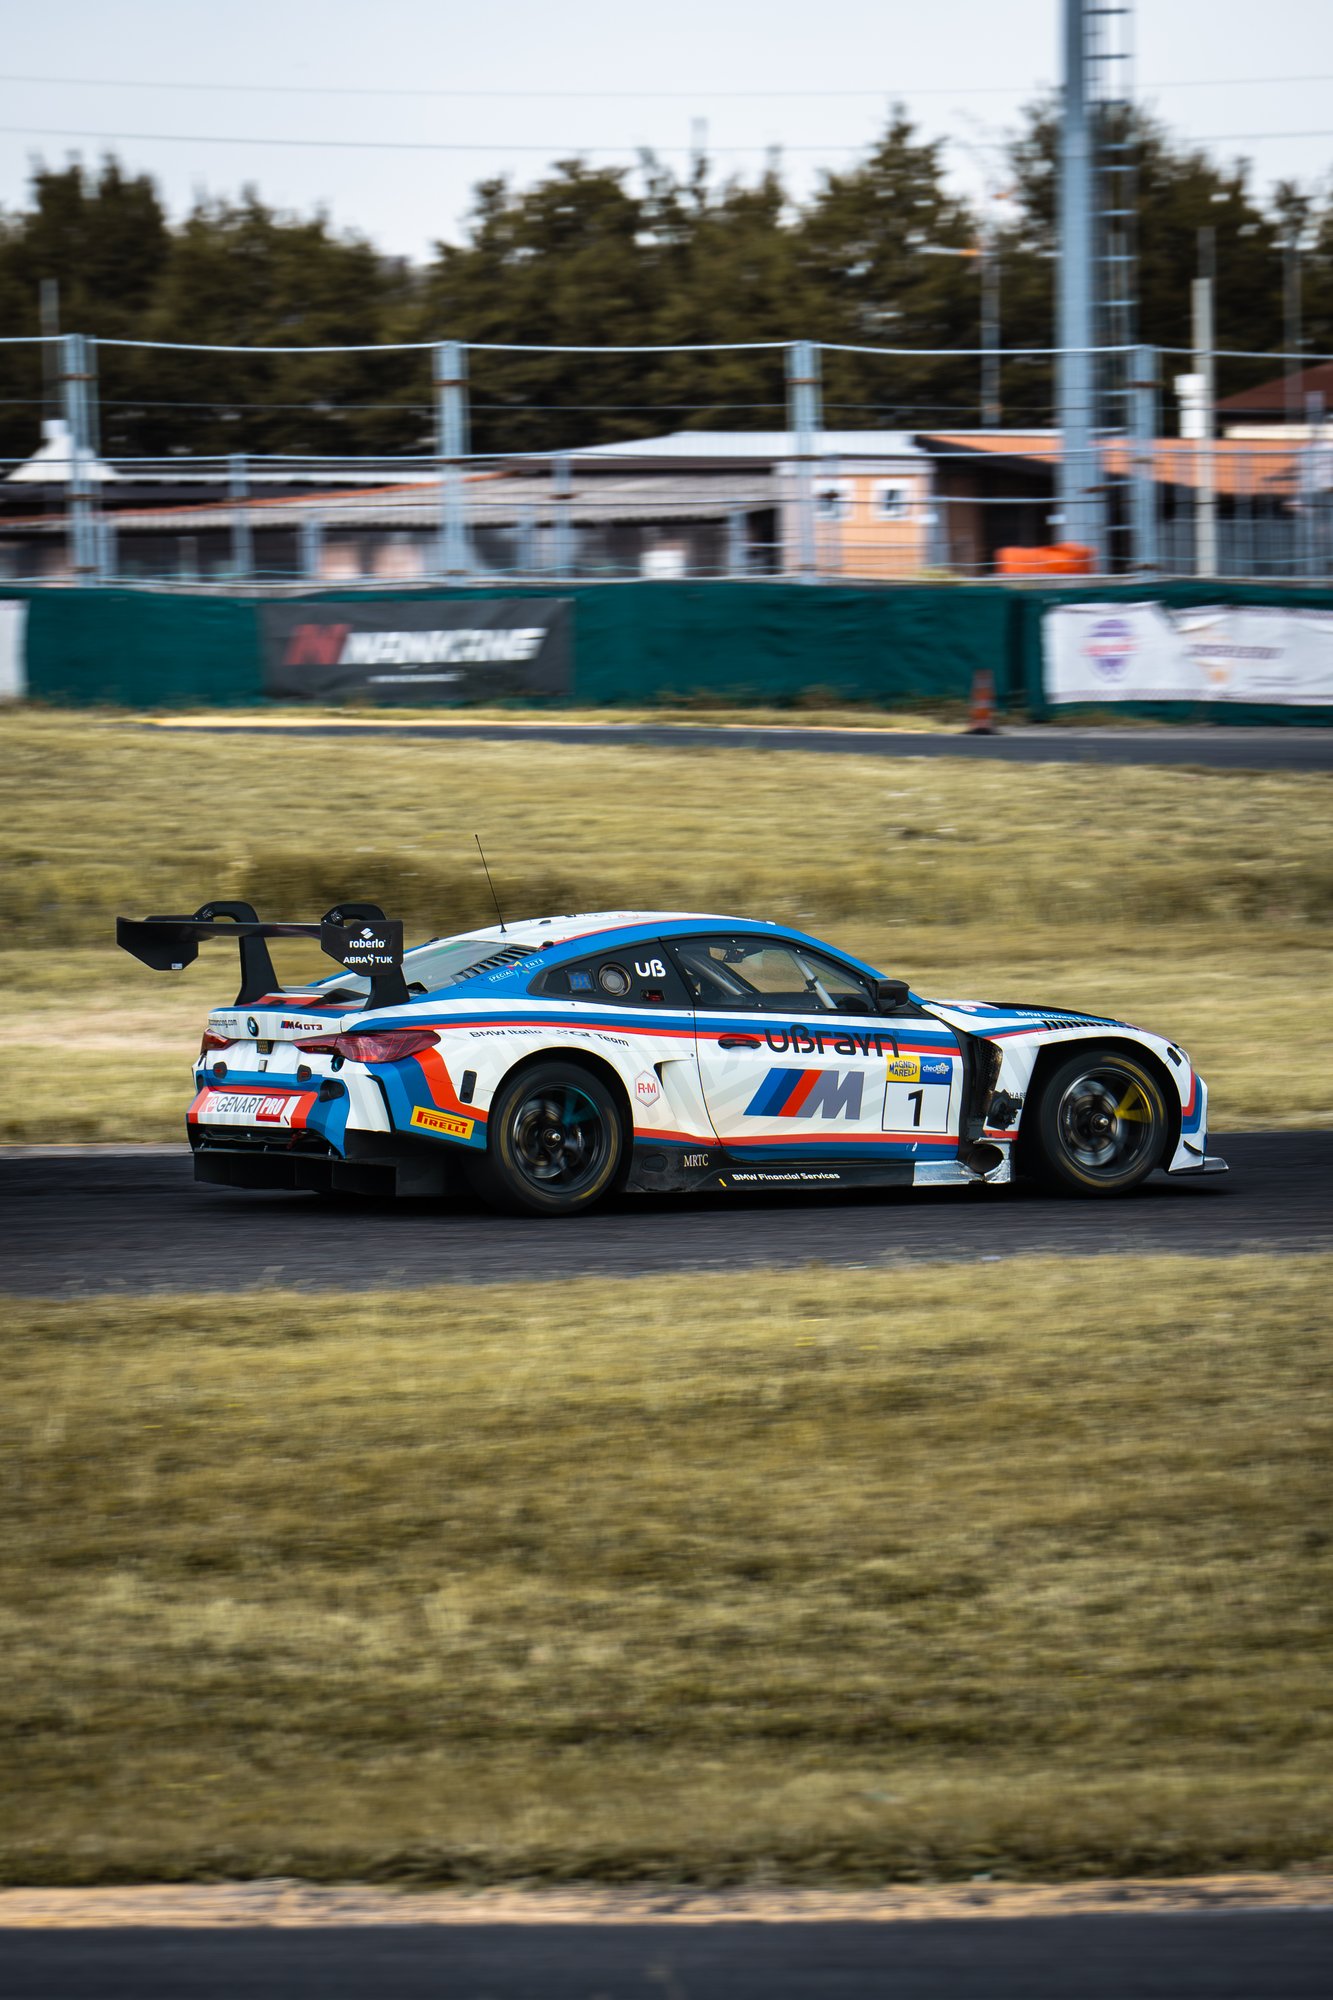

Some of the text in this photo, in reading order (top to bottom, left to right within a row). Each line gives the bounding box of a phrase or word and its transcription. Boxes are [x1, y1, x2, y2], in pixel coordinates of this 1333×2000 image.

[349, 939, 385, 949] roberlo
[1016, 1010, 1041, 1018] BMW
[304, 1023, 323, 1031] GT3
[469, 1030, 506, 1038] BMW
[593, 1033, 630, 1047] Team
[637, 1082, 657, 1094] R-M
[907, 1089, 924, 1127] 1
[416, 1110, 468, 1134] PIRELLI
[683, 1153, 709, 1168] MRTC
[732, 1172, 841, 1181] BMW Financial Services
